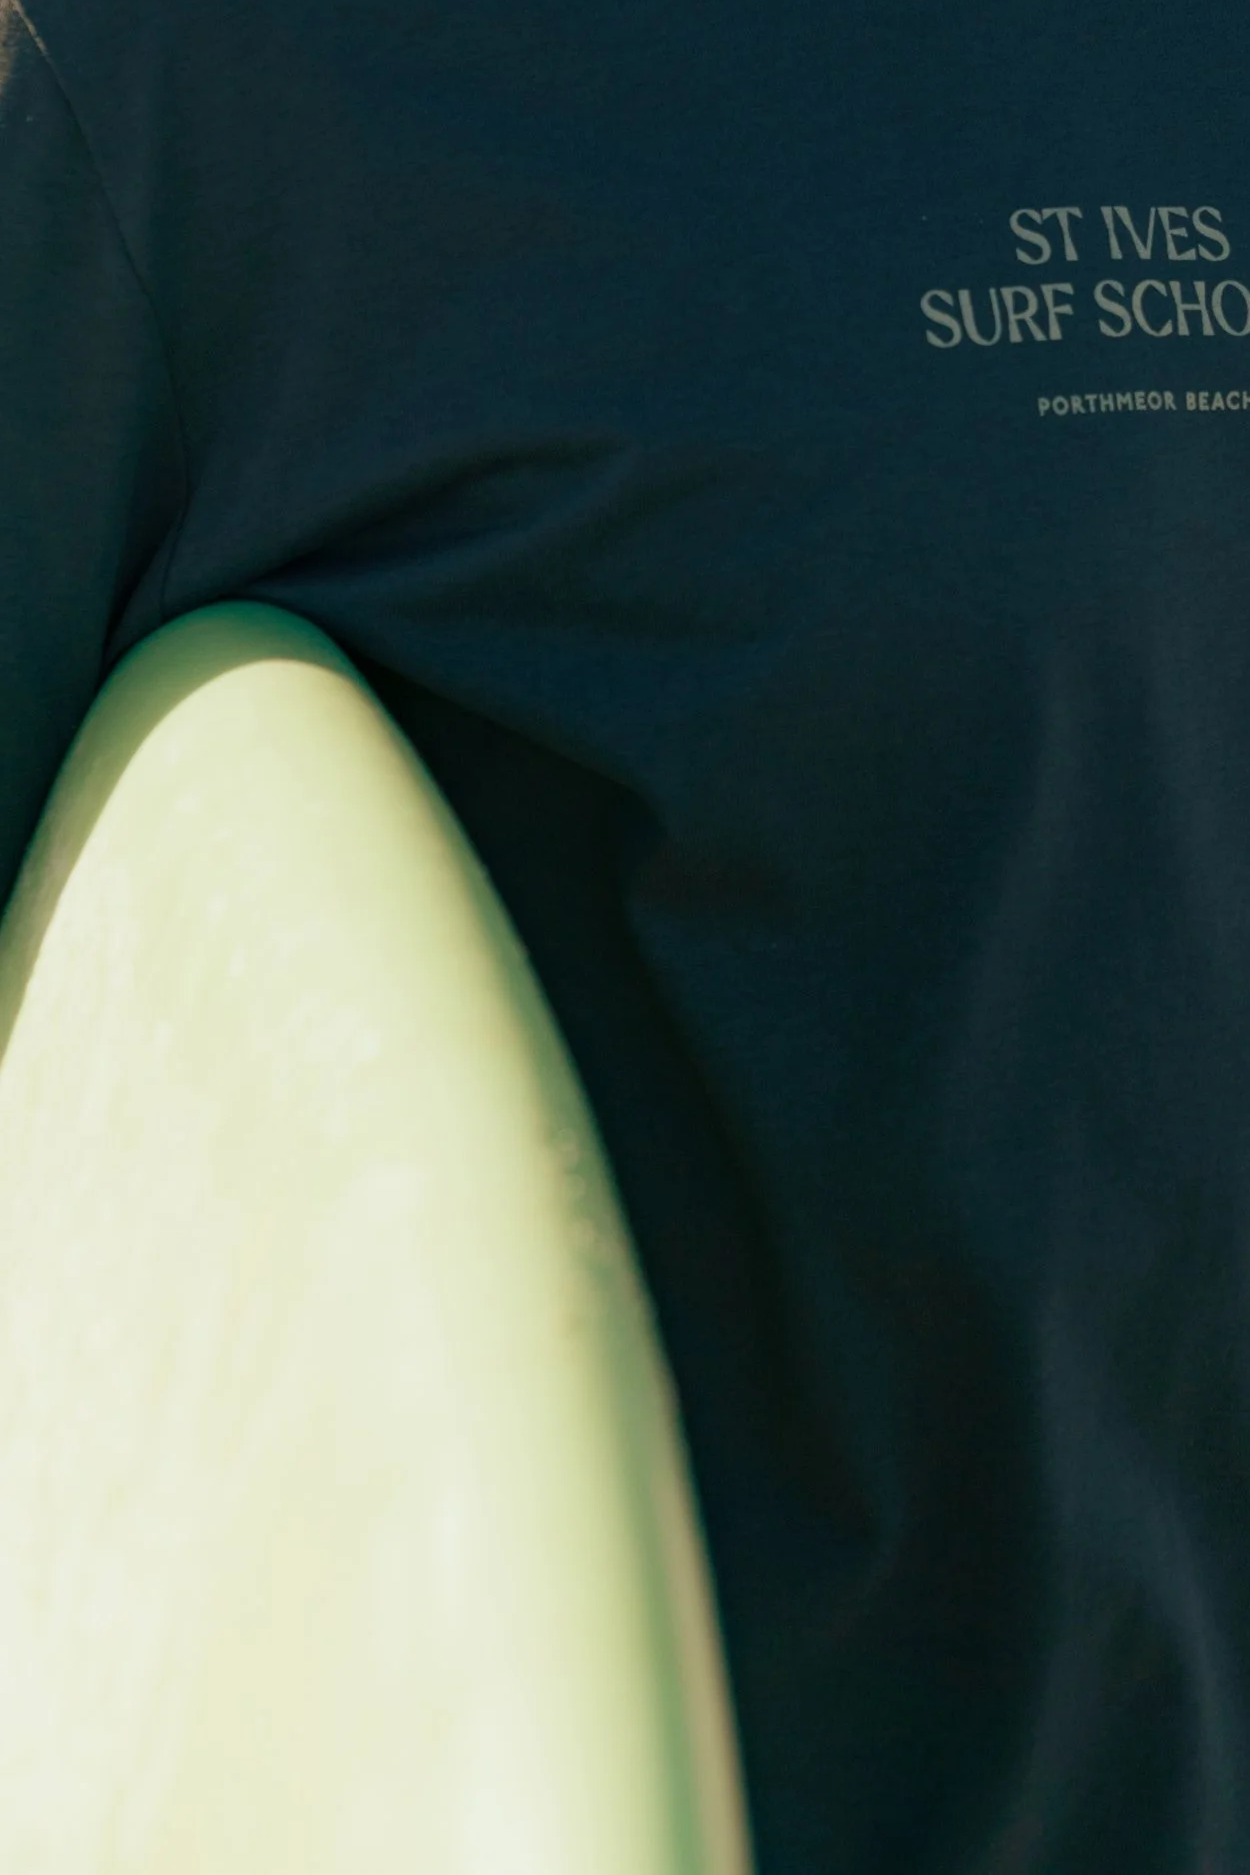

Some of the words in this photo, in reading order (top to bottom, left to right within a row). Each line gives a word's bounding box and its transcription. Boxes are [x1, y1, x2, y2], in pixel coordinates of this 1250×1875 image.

[1009, 206, 1083, 265] ST
[1100, 205, 1231, 262] IVES
[920, 282, 1074, 348] SURF
[1037, 390, 1177, 417] PORTHMEOR
